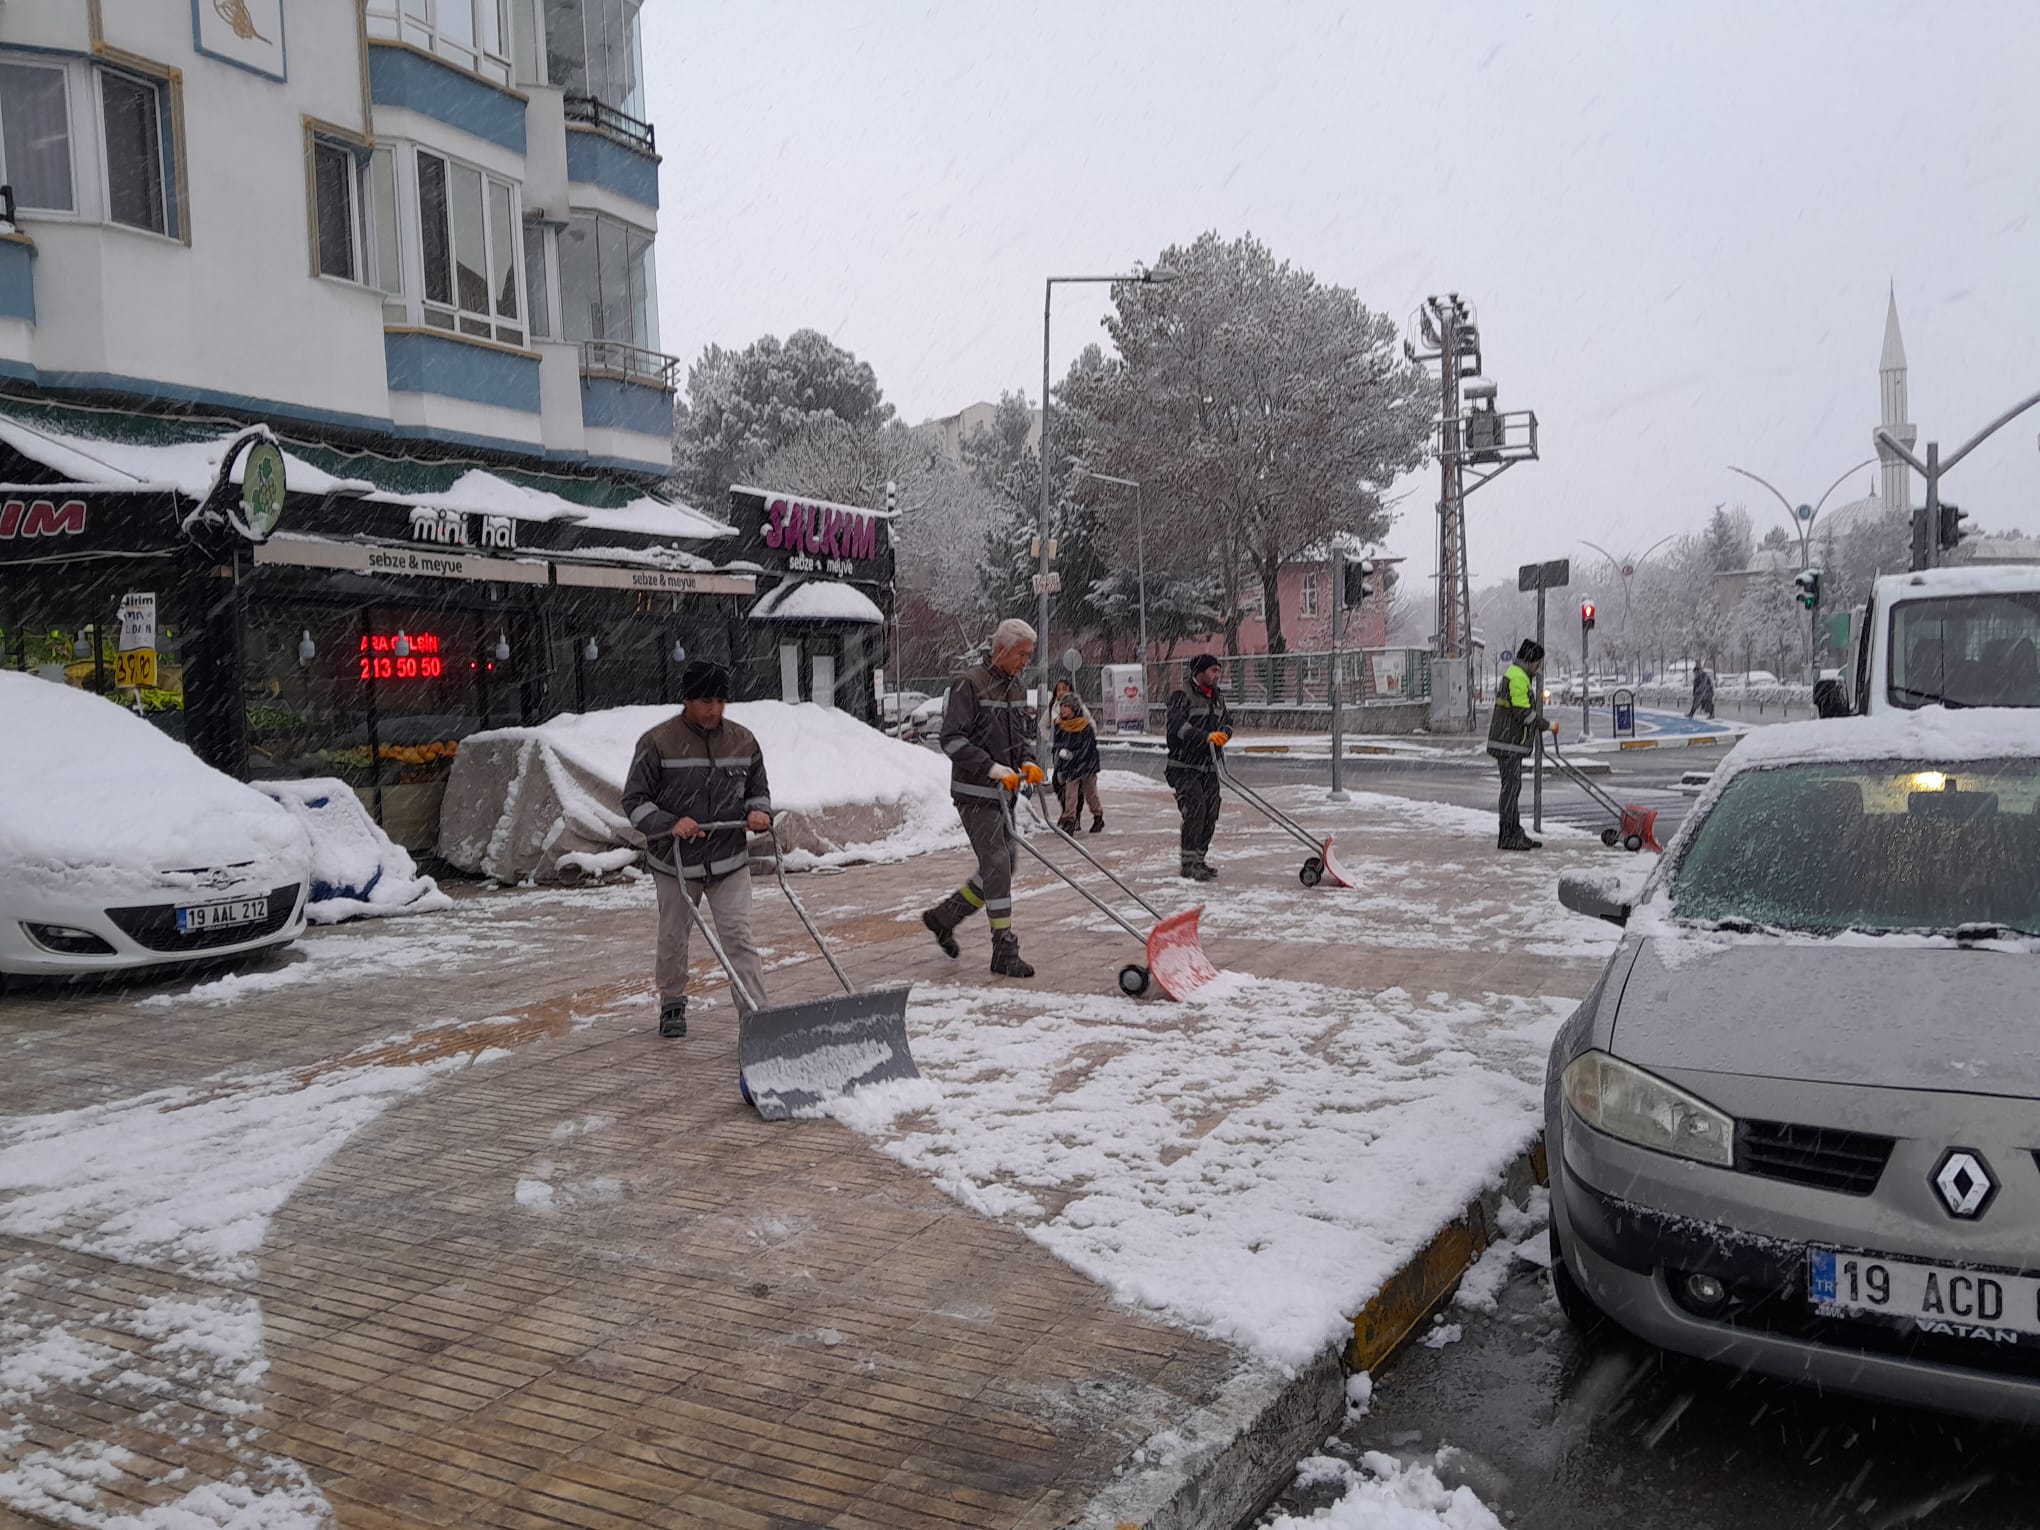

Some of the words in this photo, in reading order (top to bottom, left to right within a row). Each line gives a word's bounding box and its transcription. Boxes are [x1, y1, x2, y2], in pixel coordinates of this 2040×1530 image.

[413, 508, 469, 545] mini
[481, 515, 518, 548] hal
[766, 500, 876, 560] SALKIM
[369, 552, 406, 569] sebze
[408, 558, 419, 570] &
[790, 551, 814, 571] sebze
[826, 558, 854, 578] meyve
[632, 572, 658, 586] sebze
[360, 657, 392, 679] 213
[396, 656, 417, 678] 50
[421, 656, 441, 677] 50
[188, 909, 206, 926] 19
[212, 905, 236, 924] AAL
[242, 901, 265, 919] 212
[1815, 1279, 1834, 1293] TR
[1844, 1261, 1890, 1305] 19
[1921, 1272, 2003, 1320] ACD
[1915, 1318, 2018, 1344] VATAN
